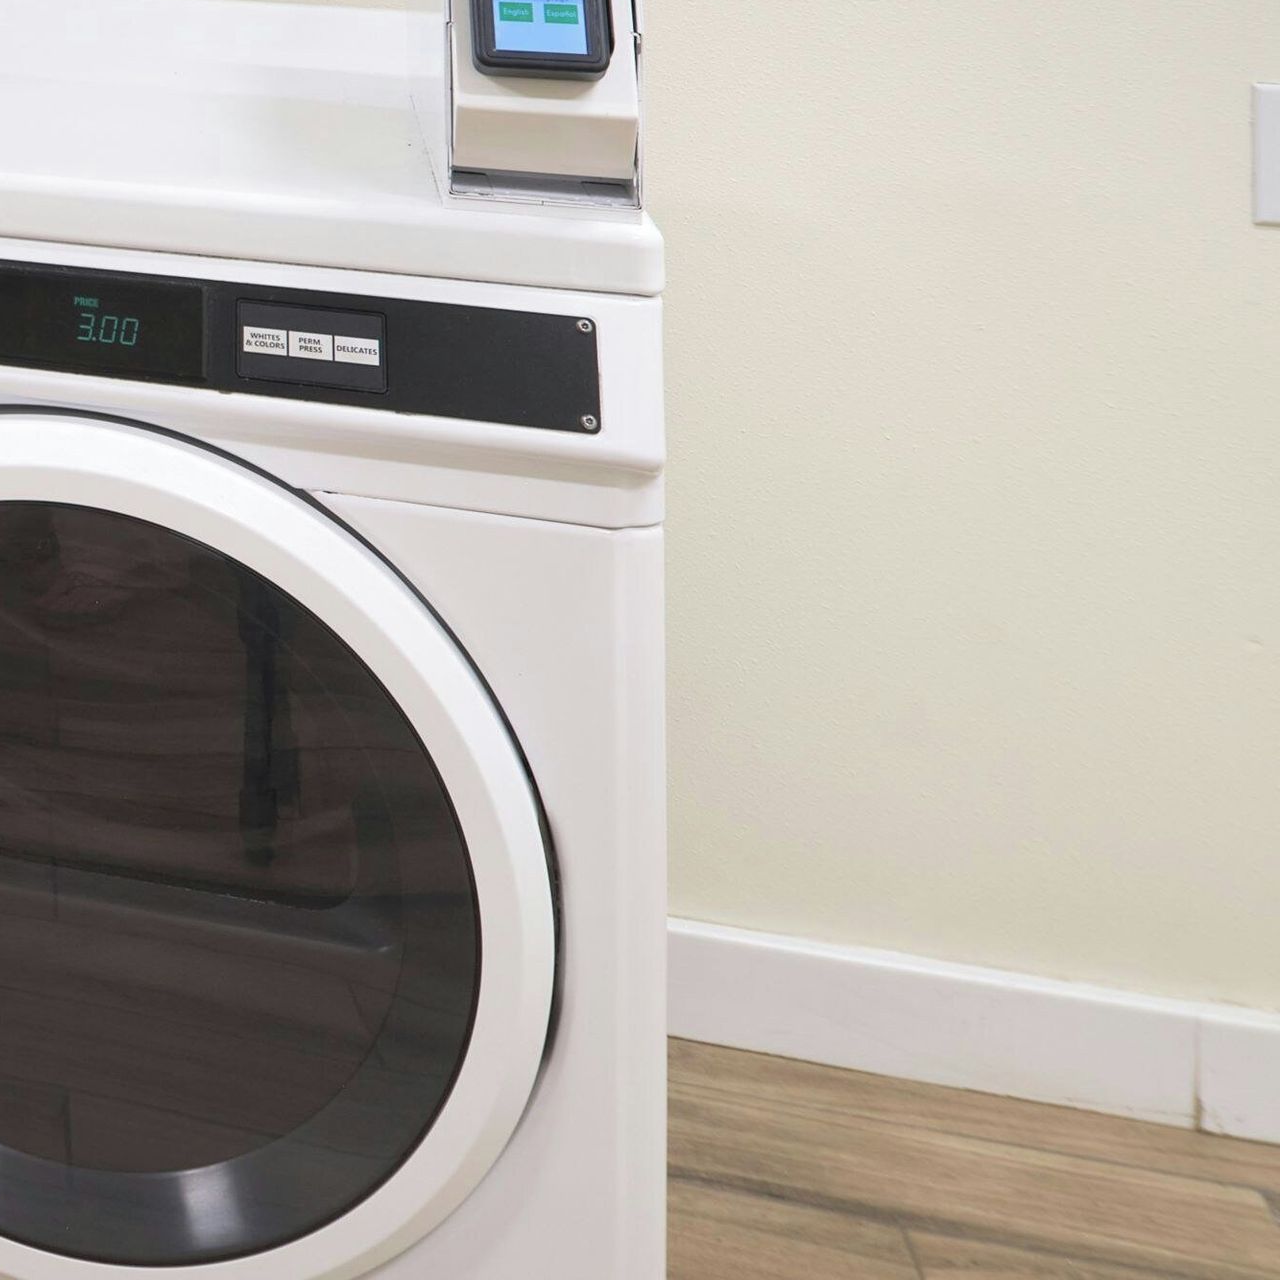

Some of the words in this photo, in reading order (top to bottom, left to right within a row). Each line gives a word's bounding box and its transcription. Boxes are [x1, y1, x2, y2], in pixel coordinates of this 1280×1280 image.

[503, 7, 529, 18] English
[74, 296, 100, 309] PRICE
[77, 313, 139, 346] 3.00
[250, 332, 281, 342] WHITES
[254, 340, 285, 350] COLORS
[298, 345, 323, 354] PRESS
[336, 345, 378, 356] DELICATES
